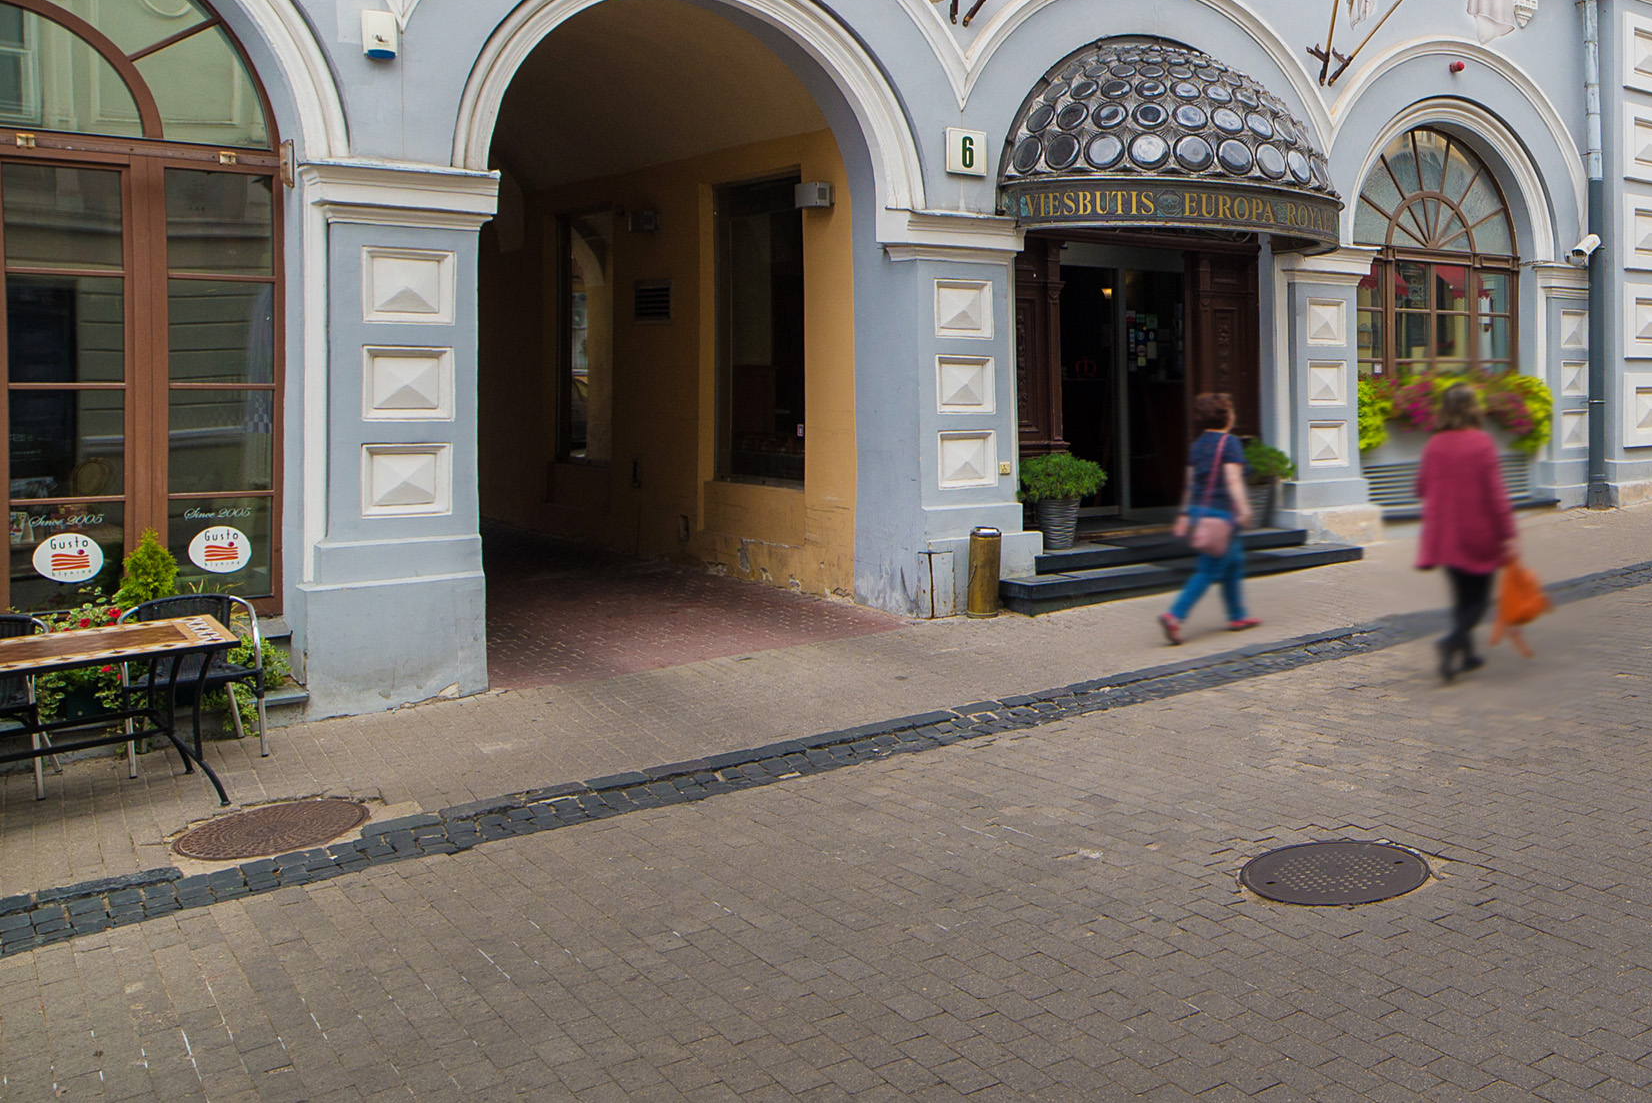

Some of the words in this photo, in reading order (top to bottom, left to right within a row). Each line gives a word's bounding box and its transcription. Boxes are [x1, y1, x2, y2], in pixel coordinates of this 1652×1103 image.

[961, 135, 975, 169] 6
[1184, 190, 1276, 223] EUROPA
[1286, 201, 1336, 233] ROYALE
[28, 514, 64, 528] Since
[66, 513, 105, 526] 2005
[184, 507, 215, 521] Since
[217, 507, 252, 518] 2005
[204, 529, 239, 542] Gusto
[50, 536, 89, 550] Gusto
